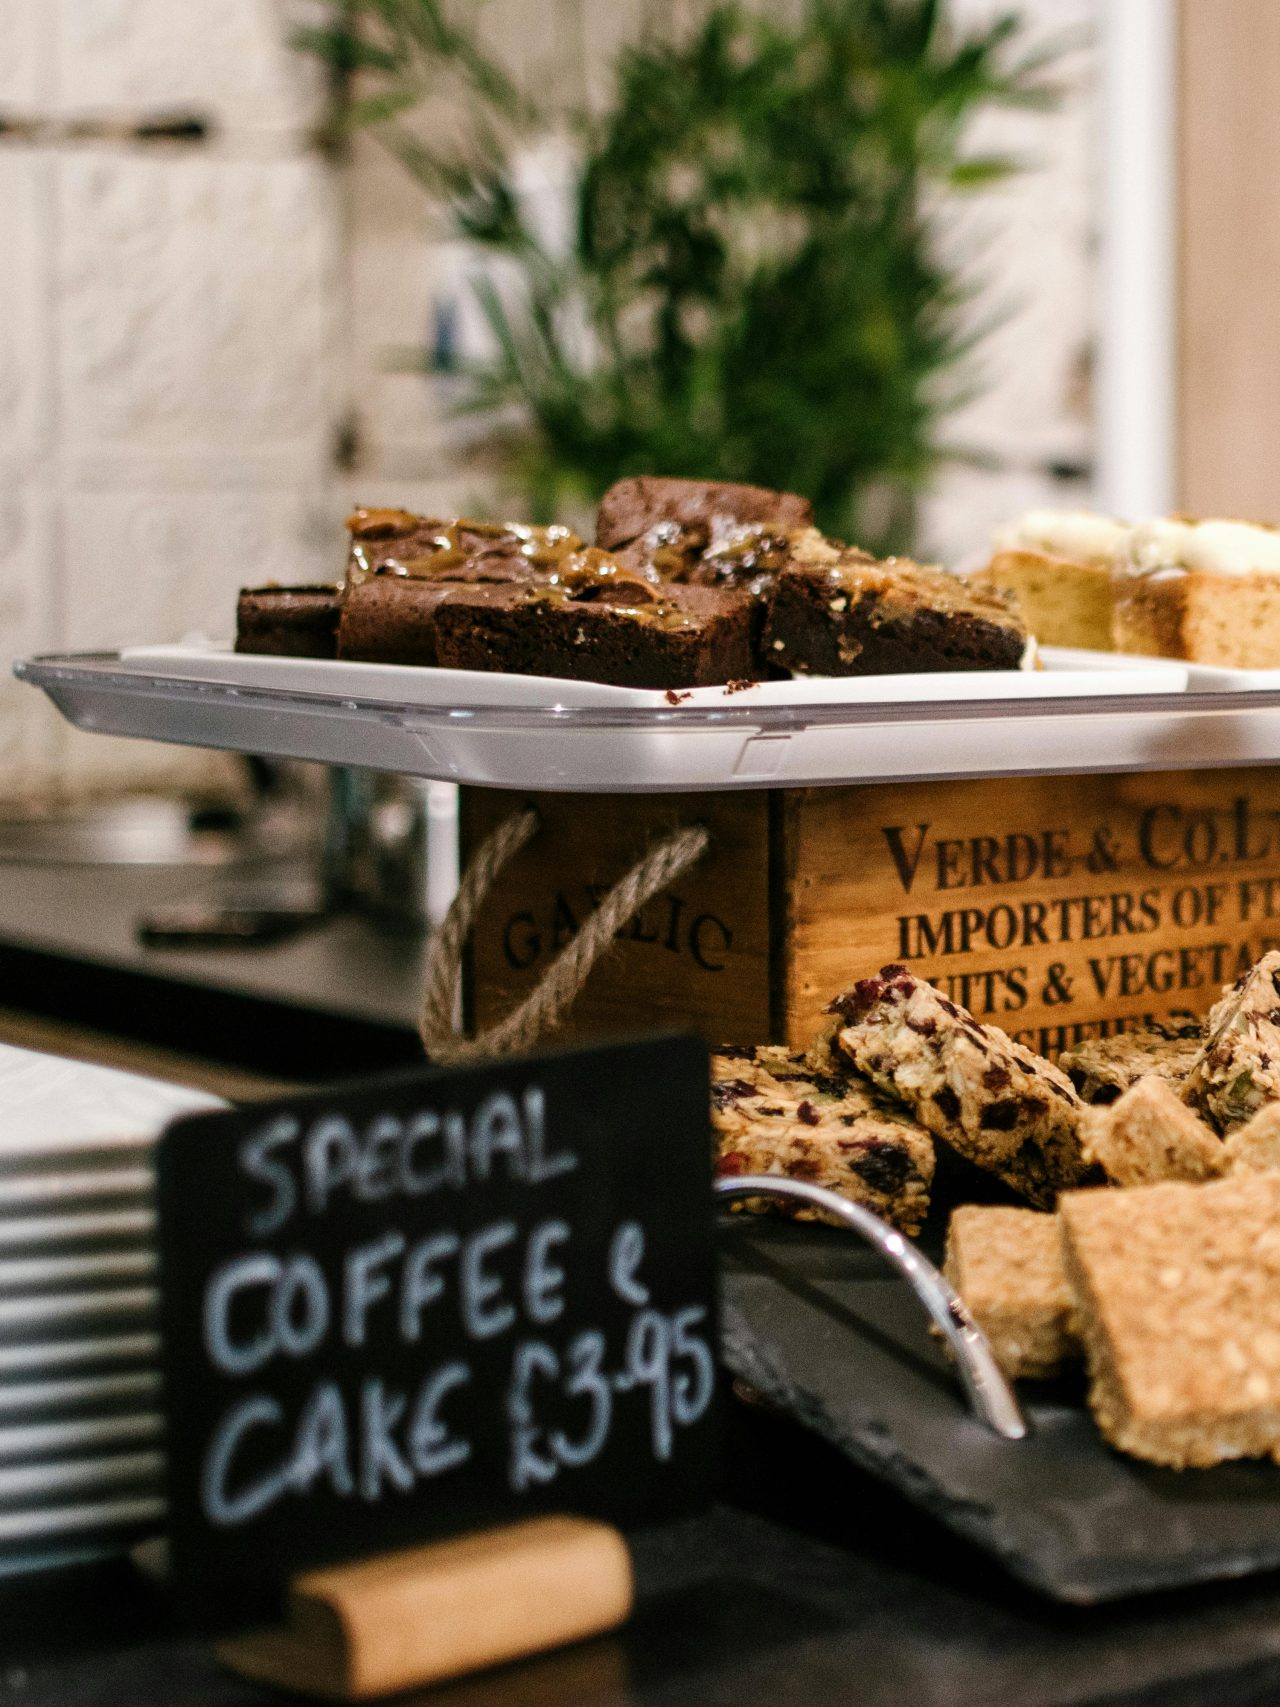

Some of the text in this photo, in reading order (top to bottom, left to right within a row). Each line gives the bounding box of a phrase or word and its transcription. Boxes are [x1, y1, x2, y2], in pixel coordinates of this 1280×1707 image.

[1088, 828, 1120, 873] &
[896, 888, 1161, 961] IMPORTERS
[1172, 883, 1238, 928] OF
[1041, 960, 1074, 1006] &
[237, 1086, 580, 1236] SPECIAL
[204, 1219, 573, 1375] COFFEE
[203, 1361, 471, 1526] CAKE
